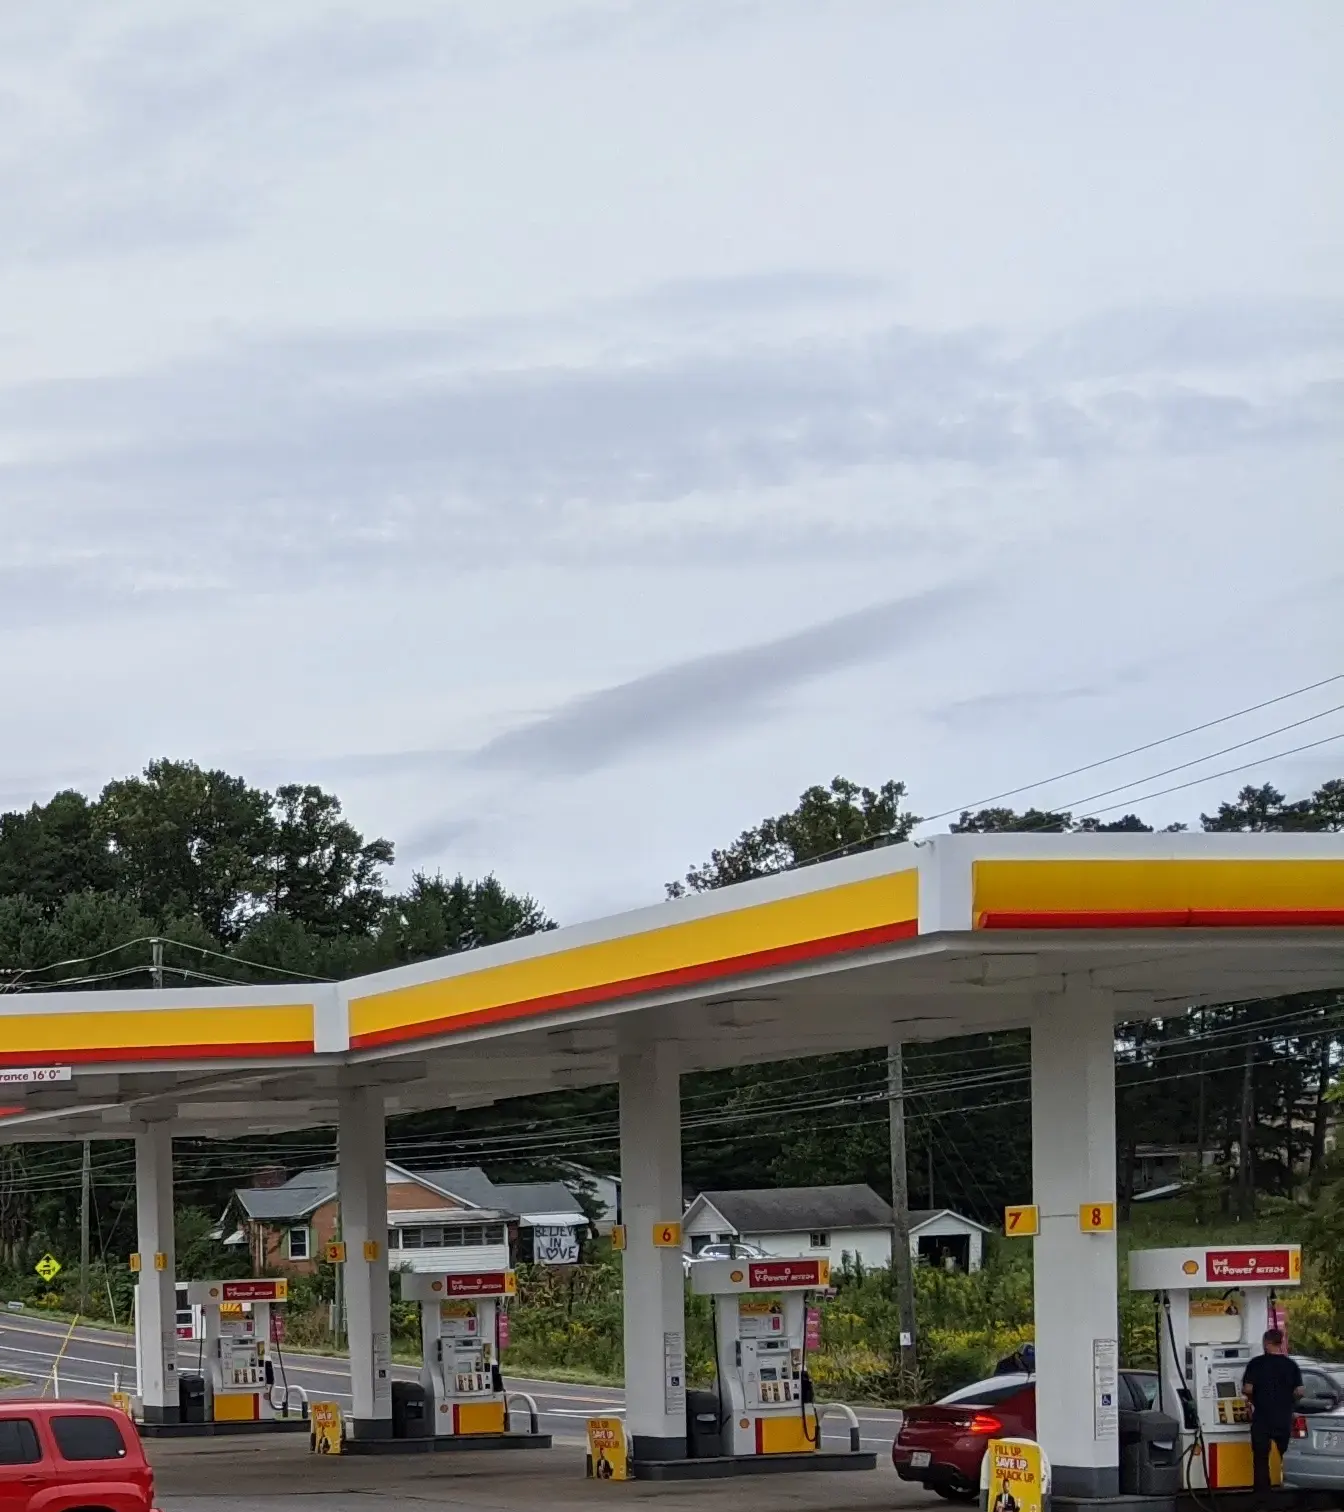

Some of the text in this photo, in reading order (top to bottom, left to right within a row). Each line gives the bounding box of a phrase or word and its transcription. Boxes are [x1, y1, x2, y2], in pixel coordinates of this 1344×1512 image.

[1008, 1212, 1022, 1230] 7
[1091, 1207, 1102, 1226] 8
[534, 1226, 573, 1237] BELIEV
[662, 1227, 672, 1242] 6
[549, 1237, 562, 1247] IN
[330, 1246, 338, 1258] 3
[995, 1444, 1009, 1456] FILL
[995, 1456, 1016, 1469] SAVE
[996, 1468, 1022, 1481] SNACK
